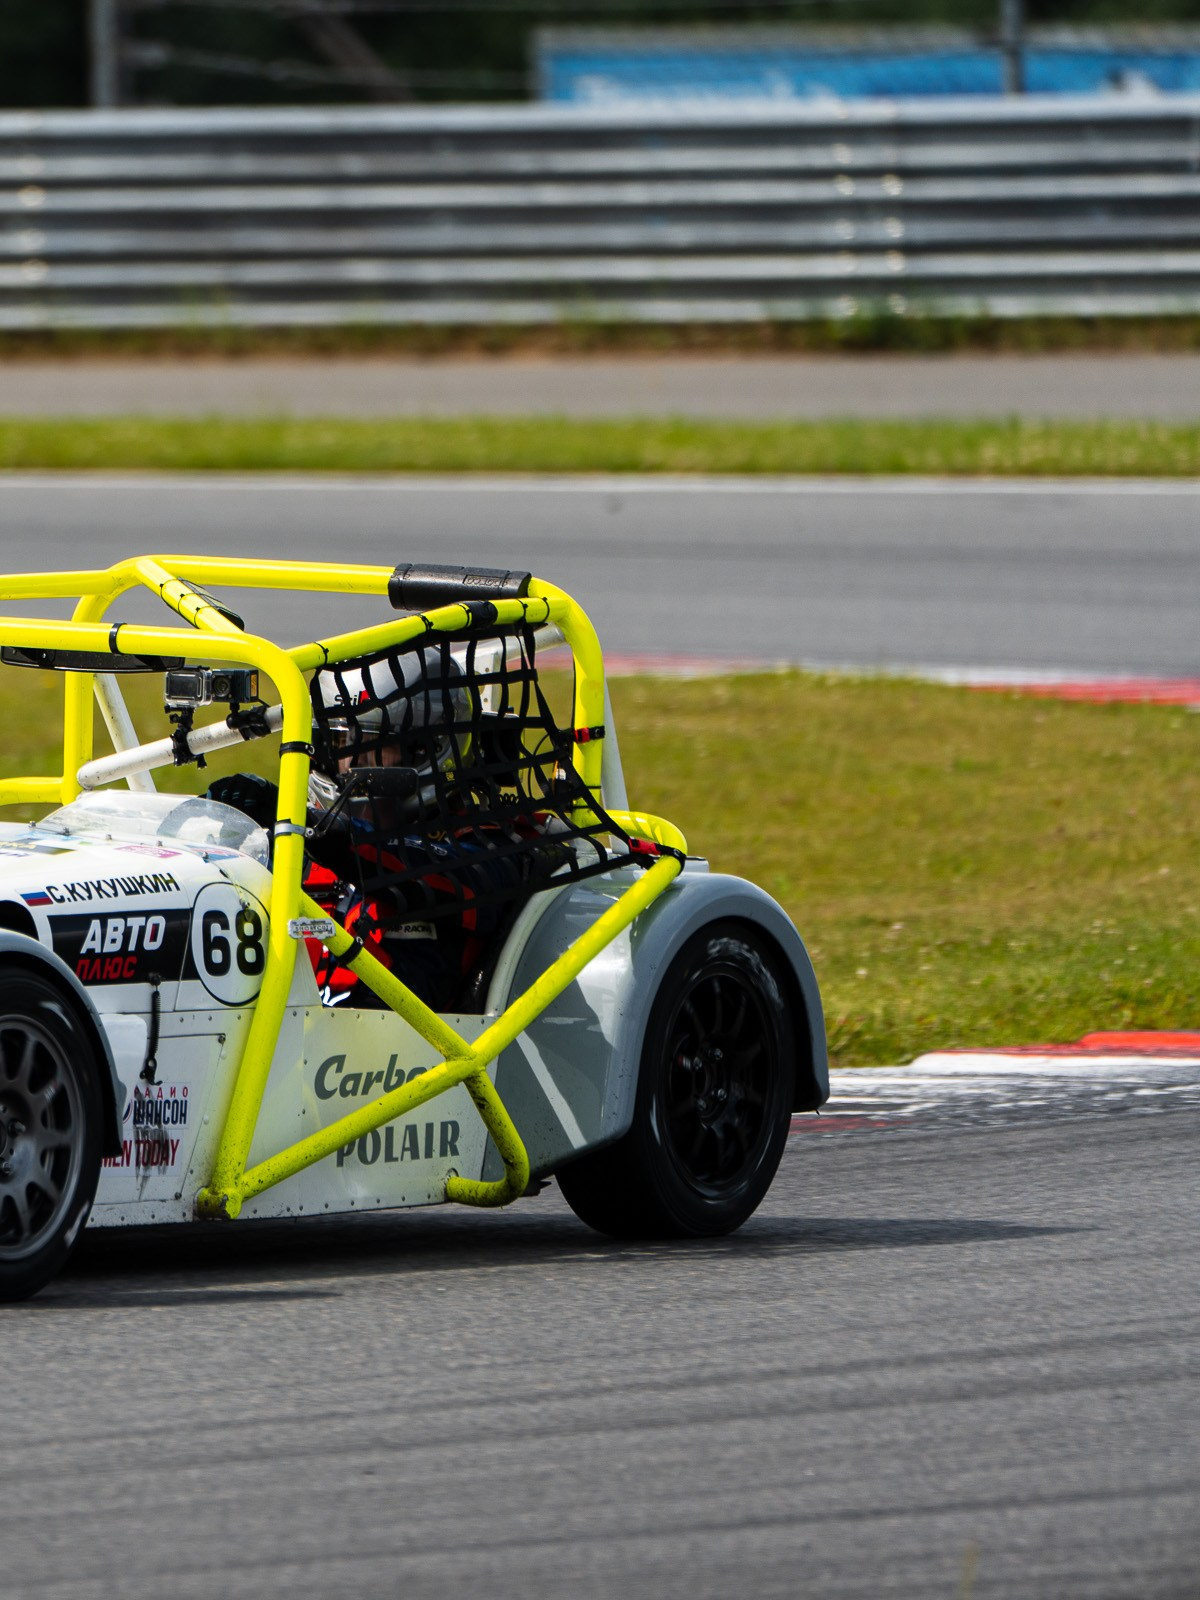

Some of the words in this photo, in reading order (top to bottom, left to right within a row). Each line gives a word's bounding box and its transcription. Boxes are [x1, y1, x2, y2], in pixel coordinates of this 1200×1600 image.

[46, 872, 181, 904] С.КУКУШКИН
[80, 915, 166, 954] АВТО
[202, 910, 266, 977] 68
[75, 956, 137, 981] ПЛЮС
[134, 1085, 189, 1100] РАДИО
[133, 1099, 188, 1126] ШАНСОН
[135, 1139, 180, 1167] TODAY
[337, 1120, 460, 1168] POLAIR
